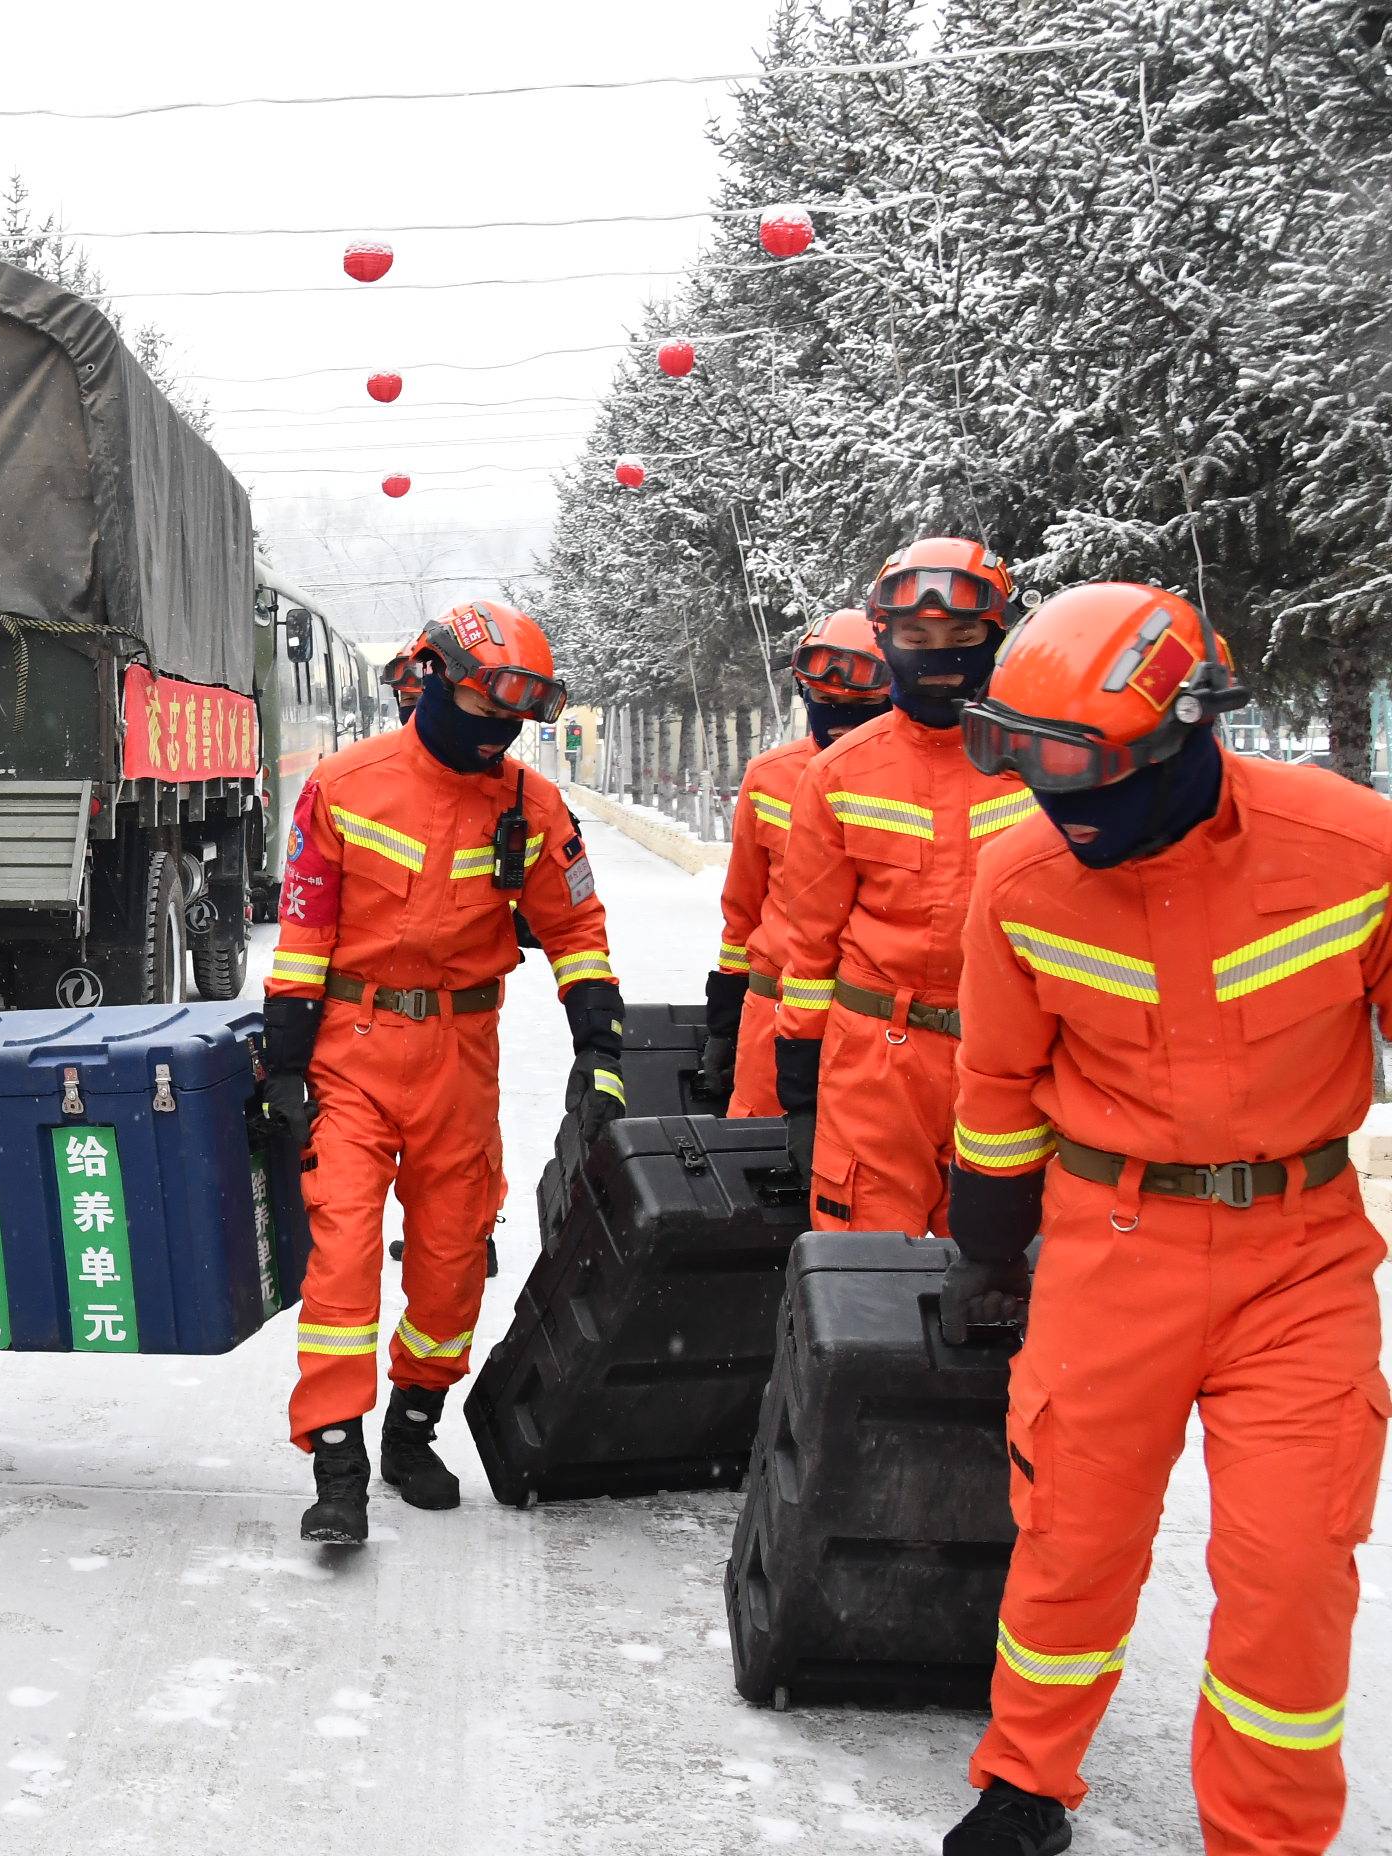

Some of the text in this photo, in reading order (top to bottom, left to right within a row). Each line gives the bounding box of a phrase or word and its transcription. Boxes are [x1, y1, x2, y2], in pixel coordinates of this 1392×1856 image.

[65, 1135, 127, 1342] 给养单元
[251, 1168, 275, 1302] 给养单元
